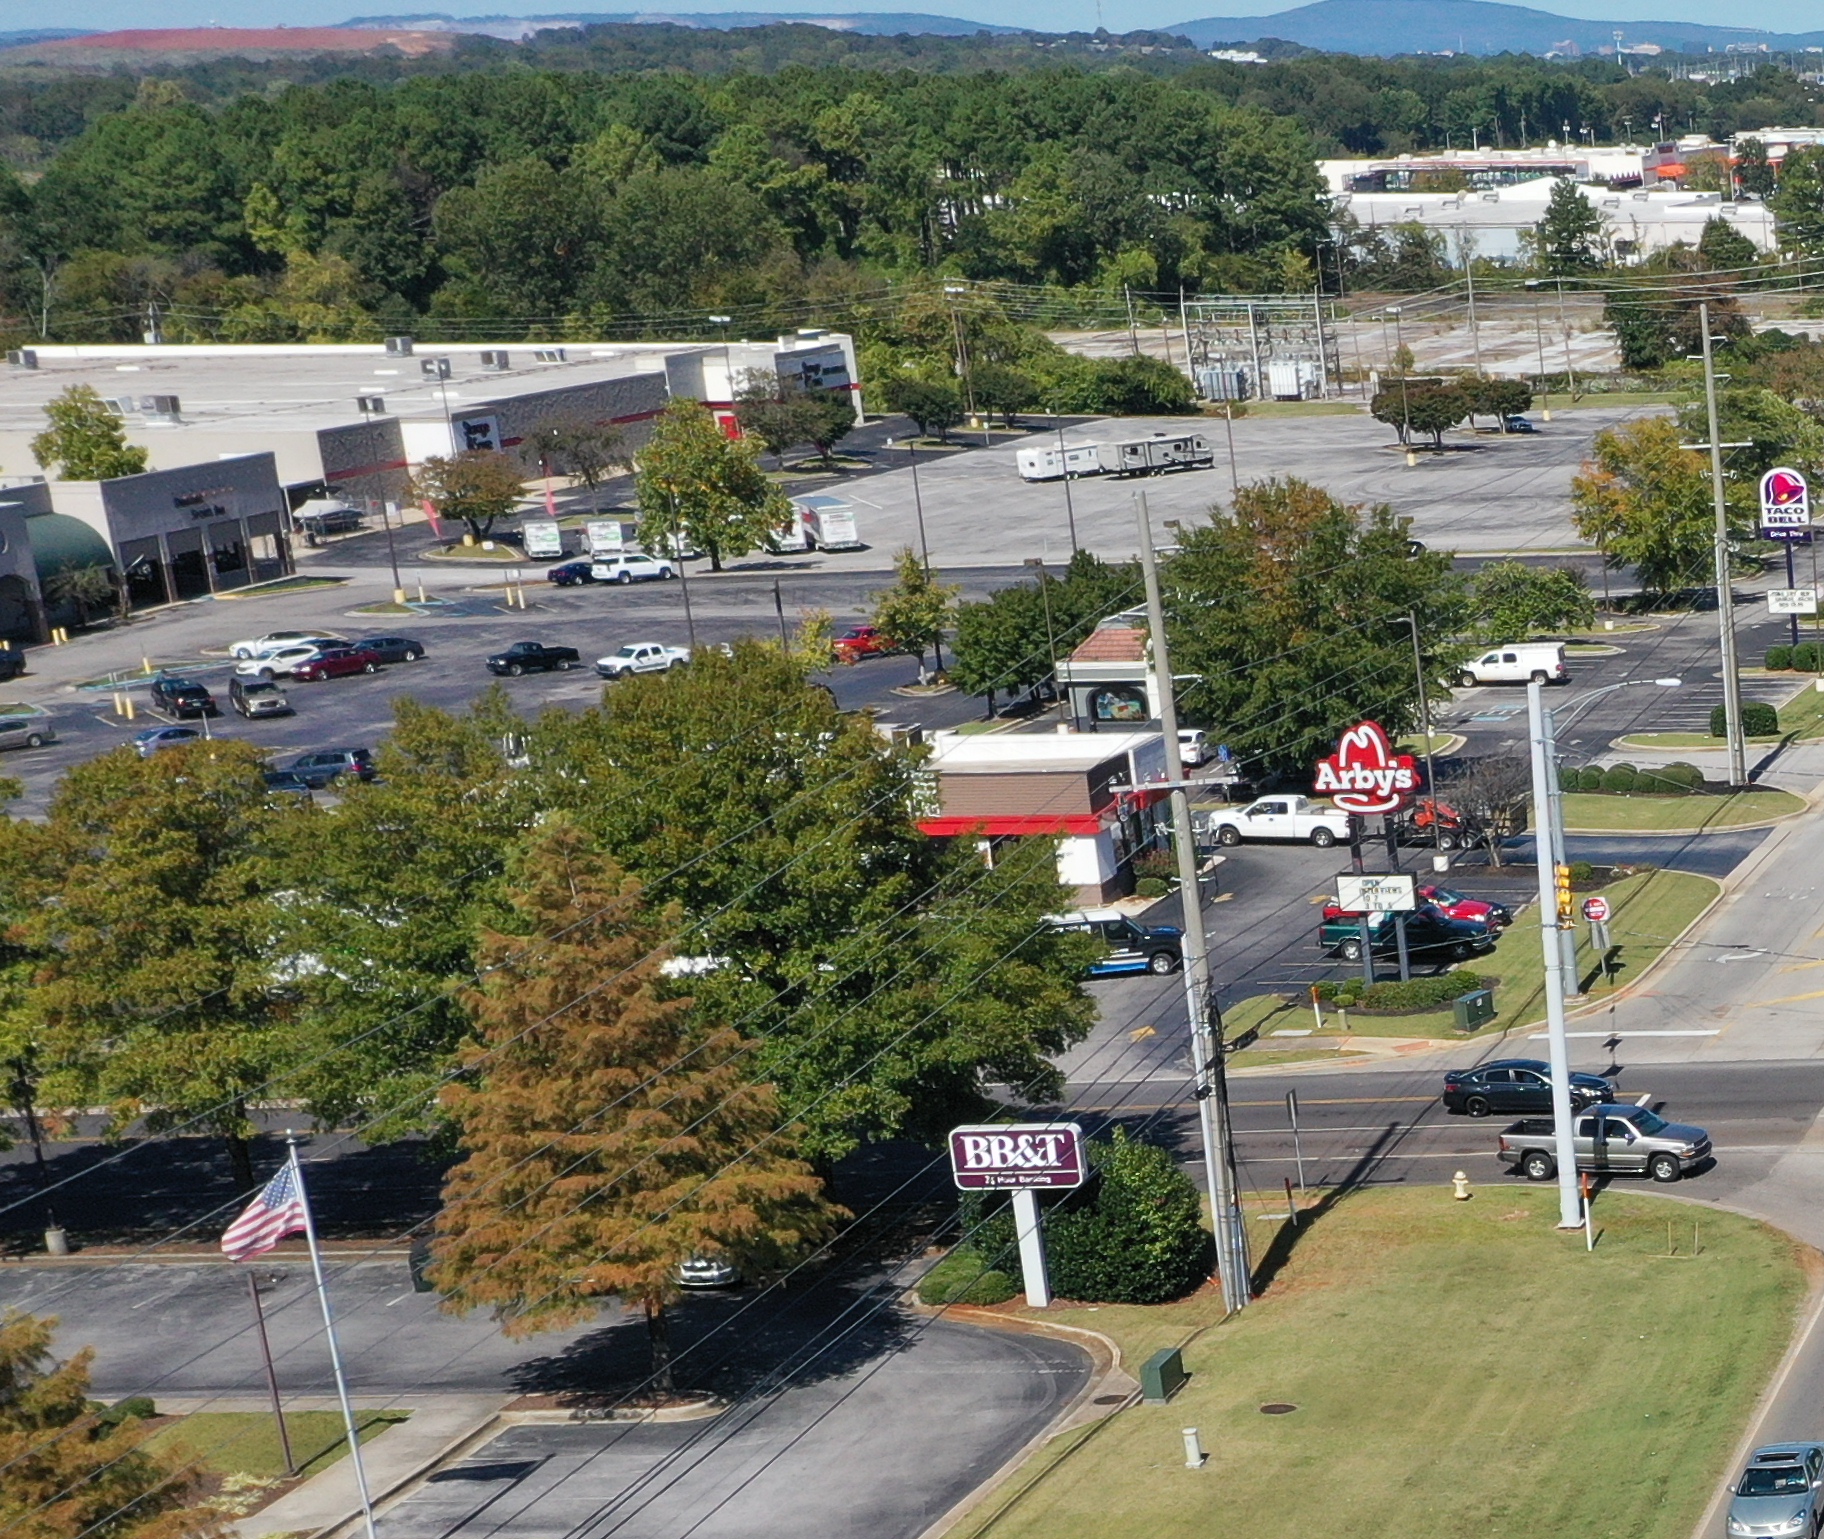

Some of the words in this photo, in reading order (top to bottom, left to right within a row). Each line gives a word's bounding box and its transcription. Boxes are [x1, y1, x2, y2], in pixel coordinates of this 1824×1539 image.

[1765, 507, 1805, 515] TACO
[1767, 516, 1806, 524] BELL
[1315, 760, 1413, 797] Arby's
[959, 1133, 1065, 1168] BB&T
